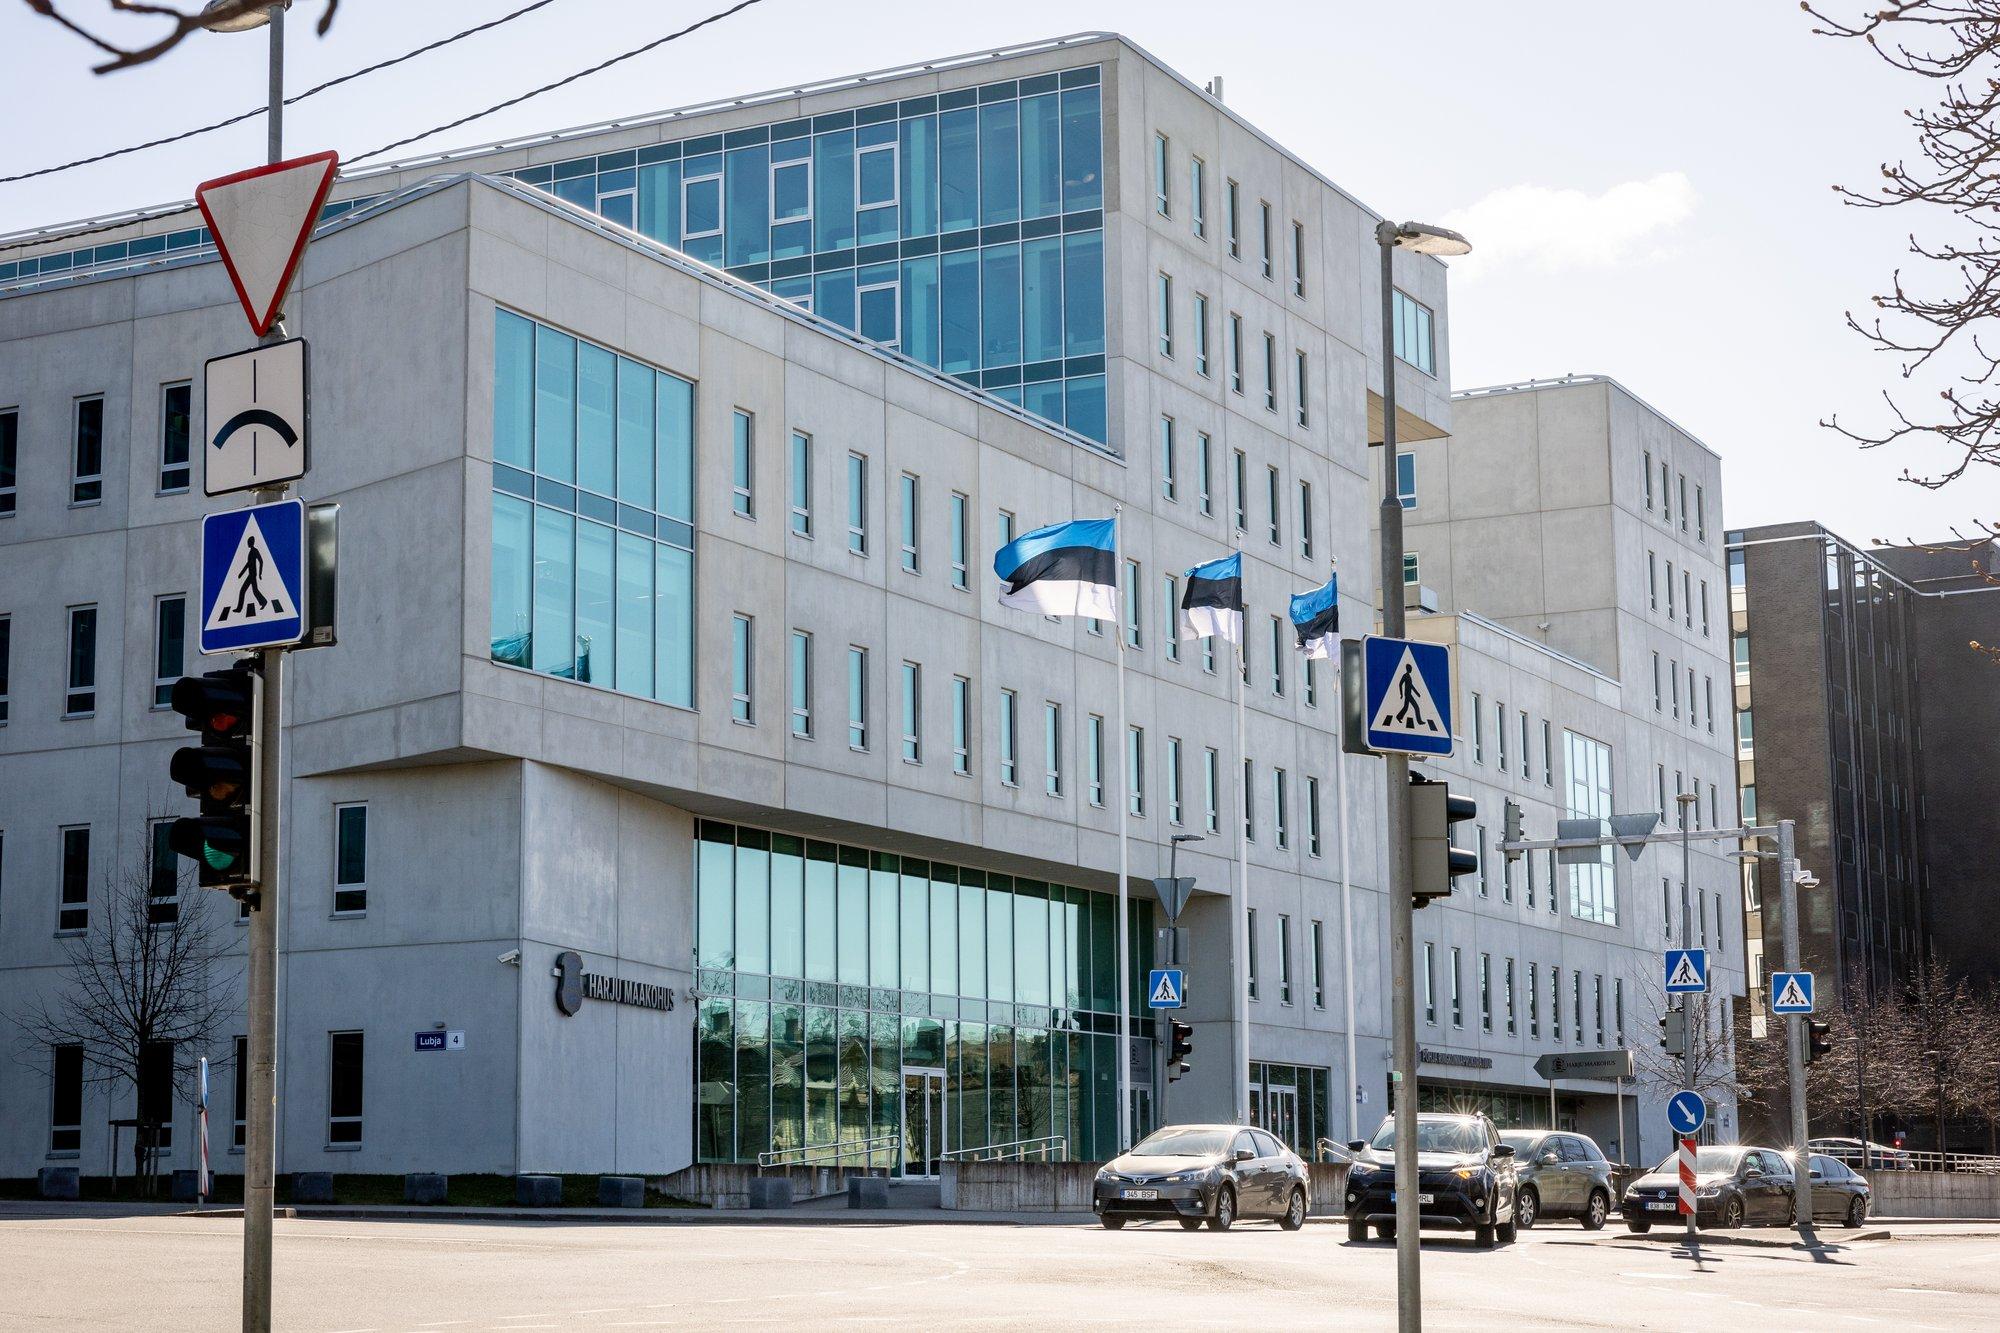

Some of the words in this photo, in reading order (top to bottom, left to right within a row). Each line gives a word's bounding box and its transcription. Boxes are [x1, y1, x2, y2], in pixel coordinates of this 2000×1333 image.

[586, 973, 622, 1002] HARJU
[624, 979, 675, 1011] MAAKOHUS
[420, 1037, 442, 1047] Lubja
[453, 1035, 459, 1044] 4
[1126, 1190, 1138, 1198] 345
